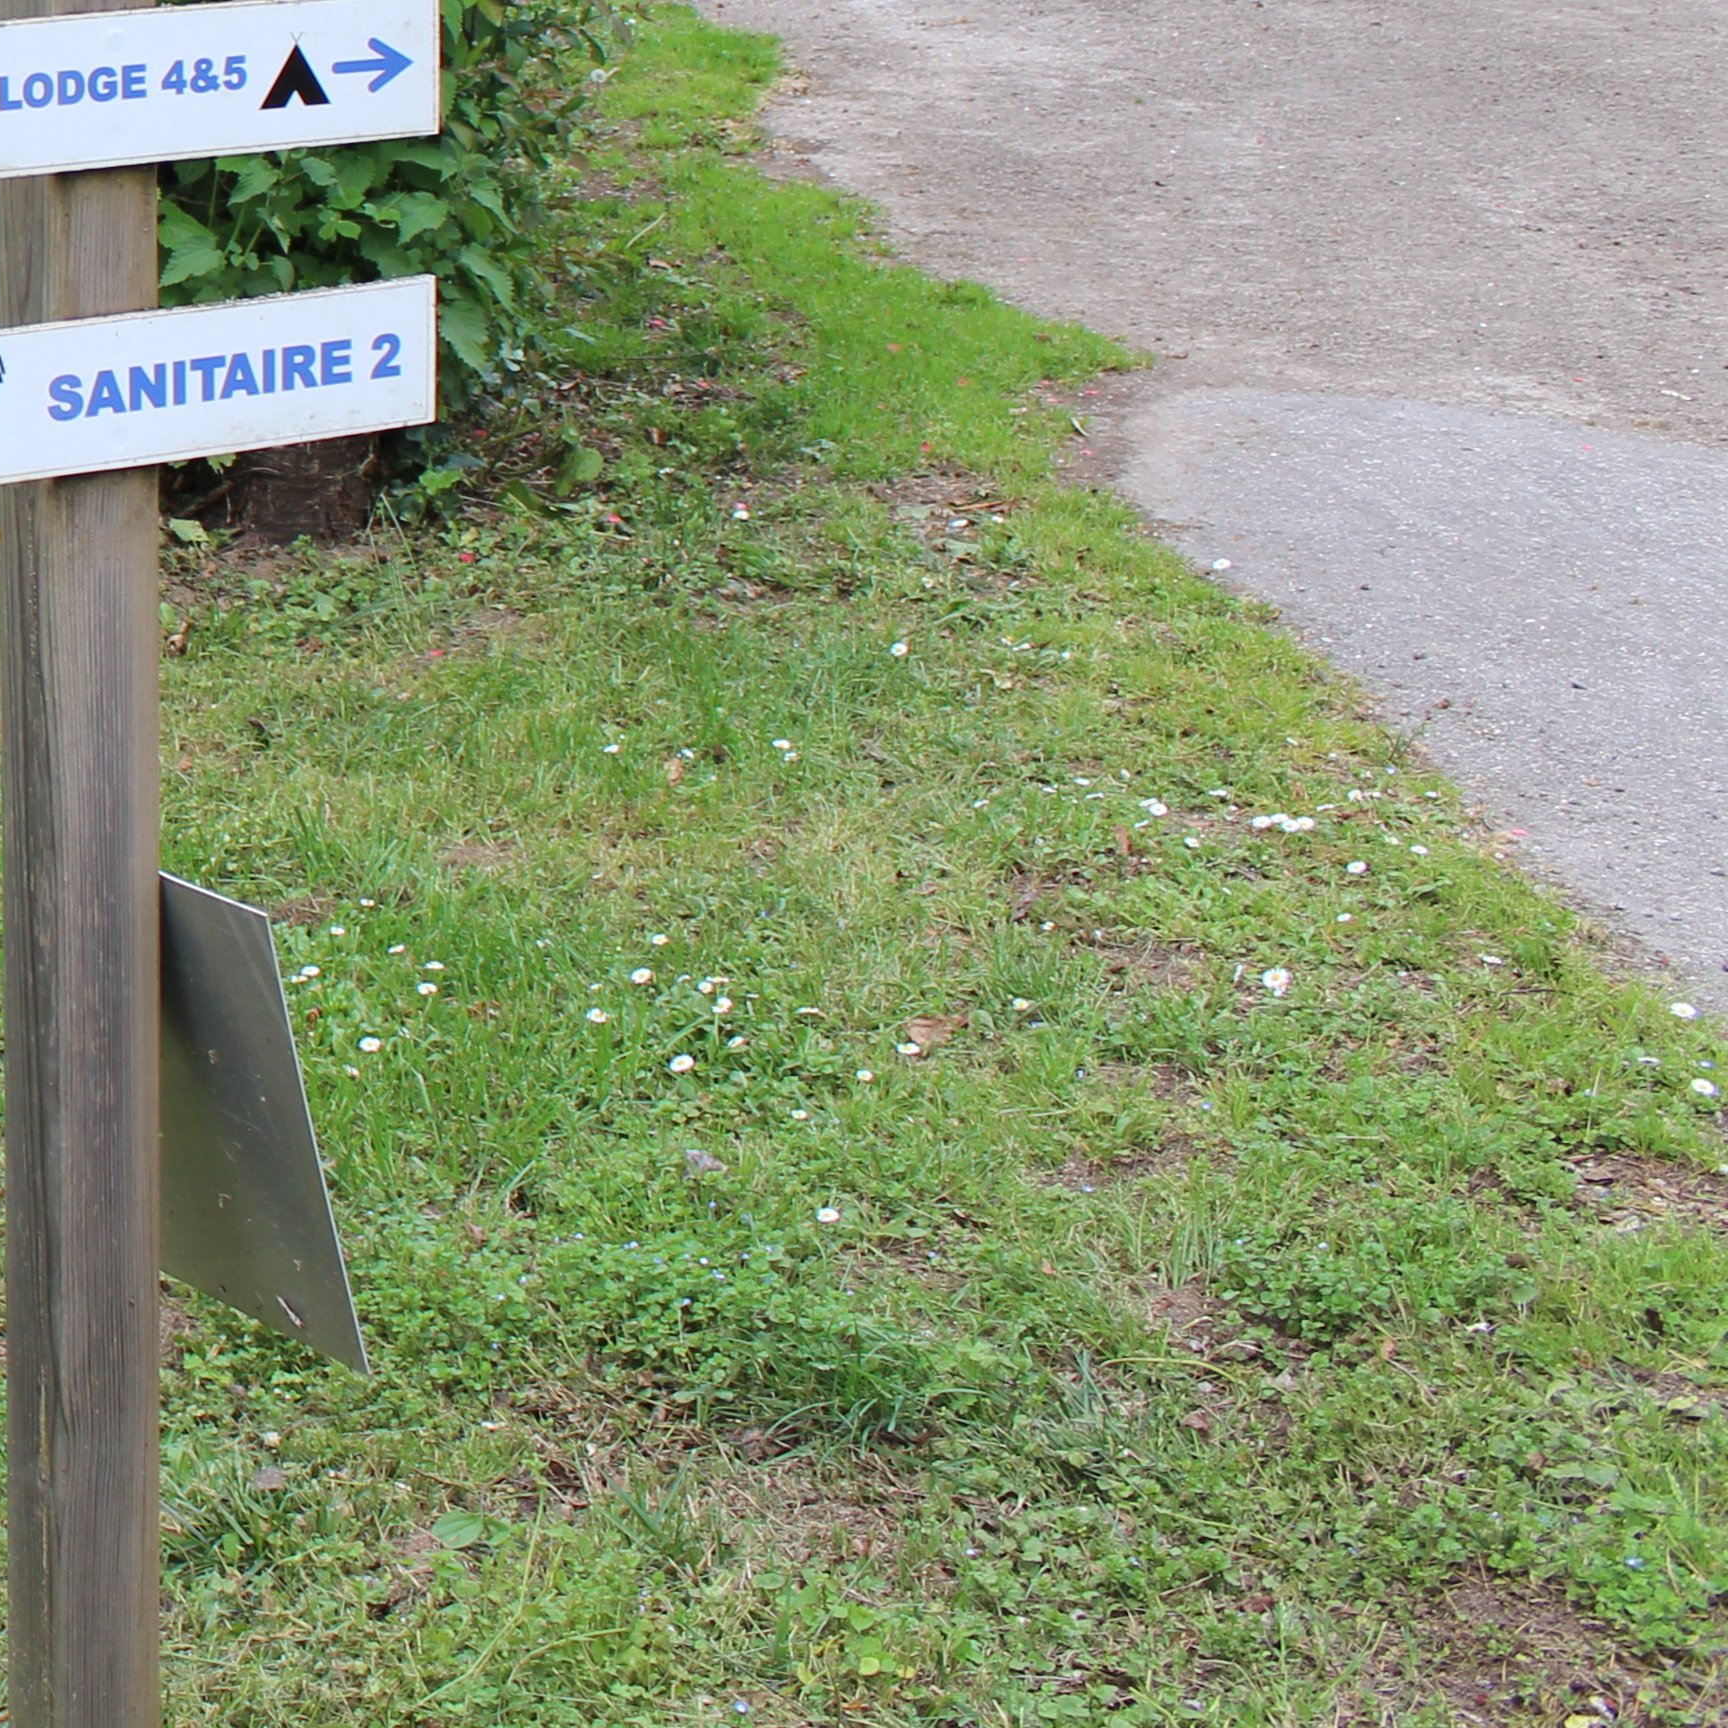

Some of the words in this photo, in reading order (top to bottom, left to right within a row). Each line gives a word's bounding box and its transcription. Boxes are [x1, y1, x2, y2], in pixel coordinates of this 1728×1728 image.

[162, 54, 249, 95] 4&5
[48, 338, 354, 423] SANITAIRE
[372, 332, 403, 380] 2
